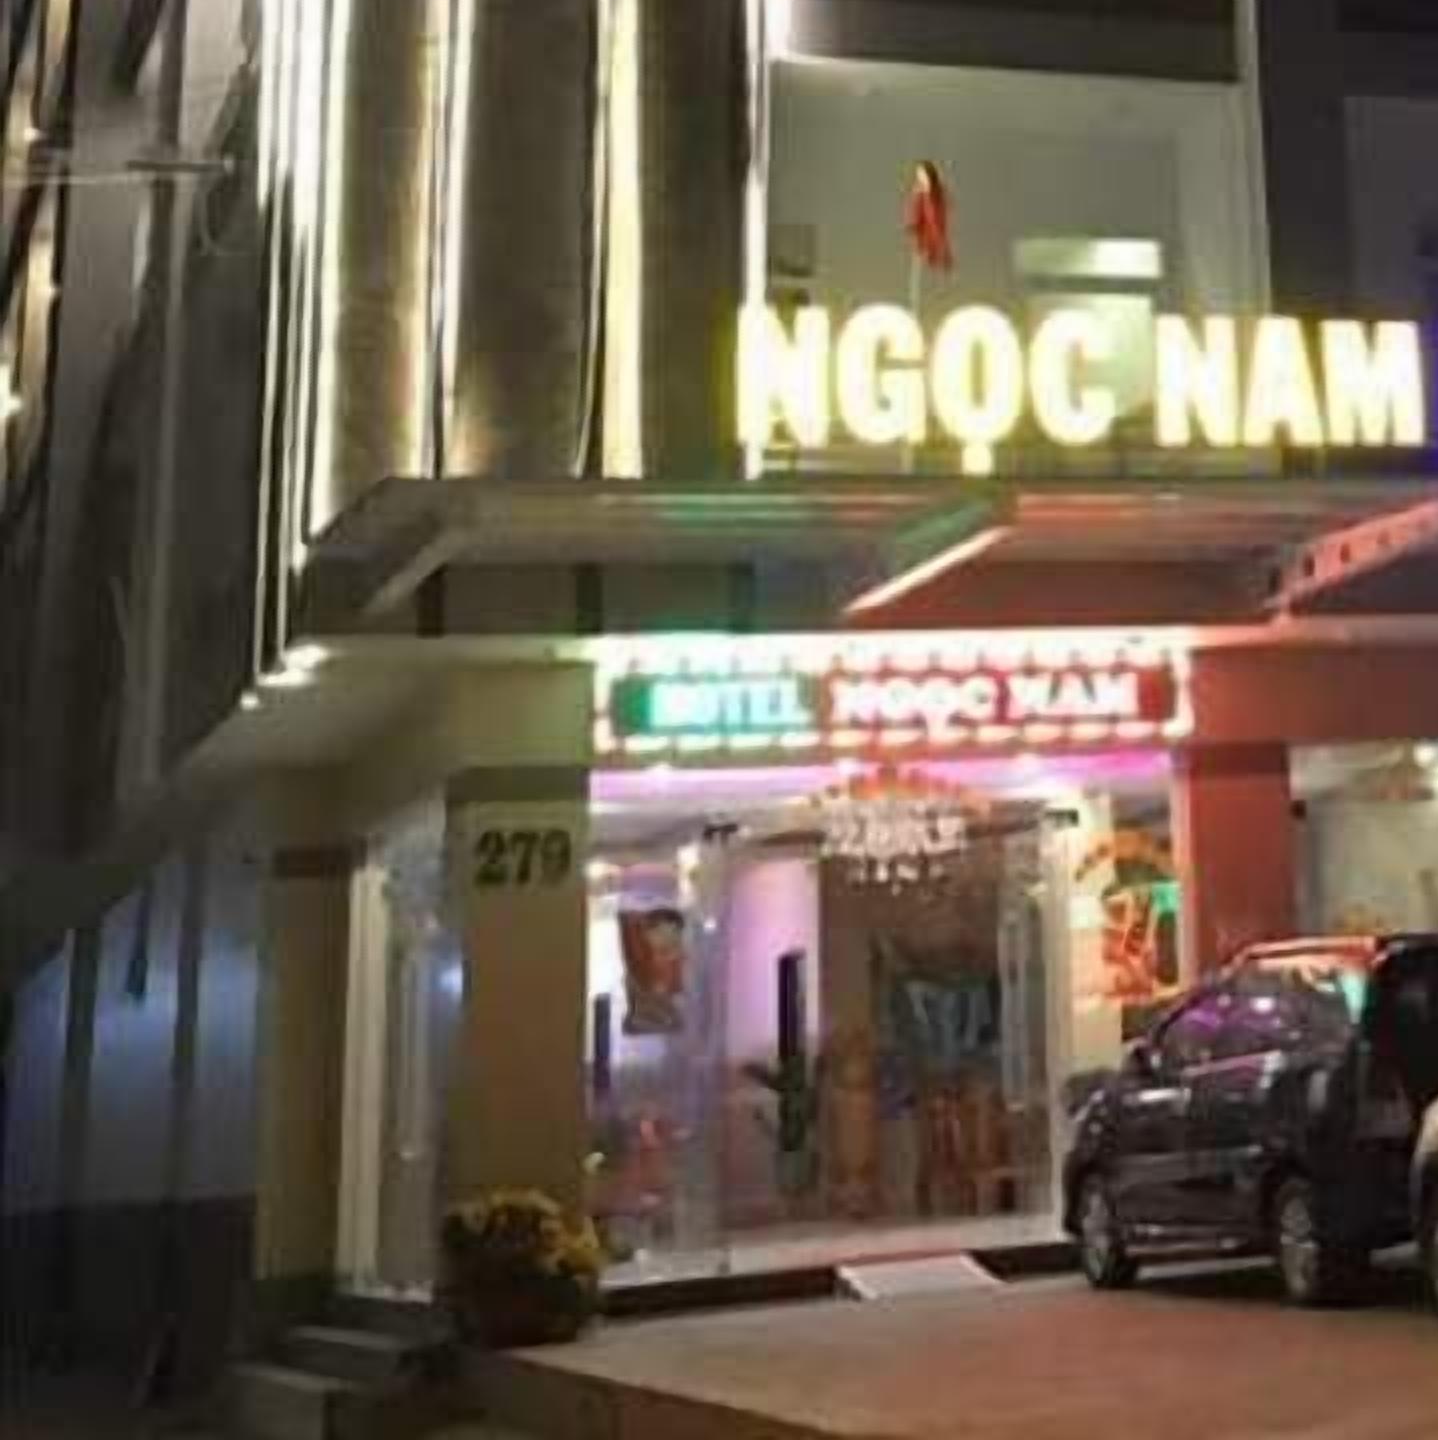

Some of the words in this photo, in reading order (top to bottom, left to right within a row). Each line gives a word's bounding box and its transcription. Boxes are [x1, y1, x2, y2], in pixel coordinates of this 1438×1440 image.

[737, 302, 1116, 476] NGỌC
[1154, 313, 1426, 447] NAM
[650, 676, 810, 728] HOTEL
[1006, 669, 1139, 720] NAM
[474, 829, 572, 888] 279
